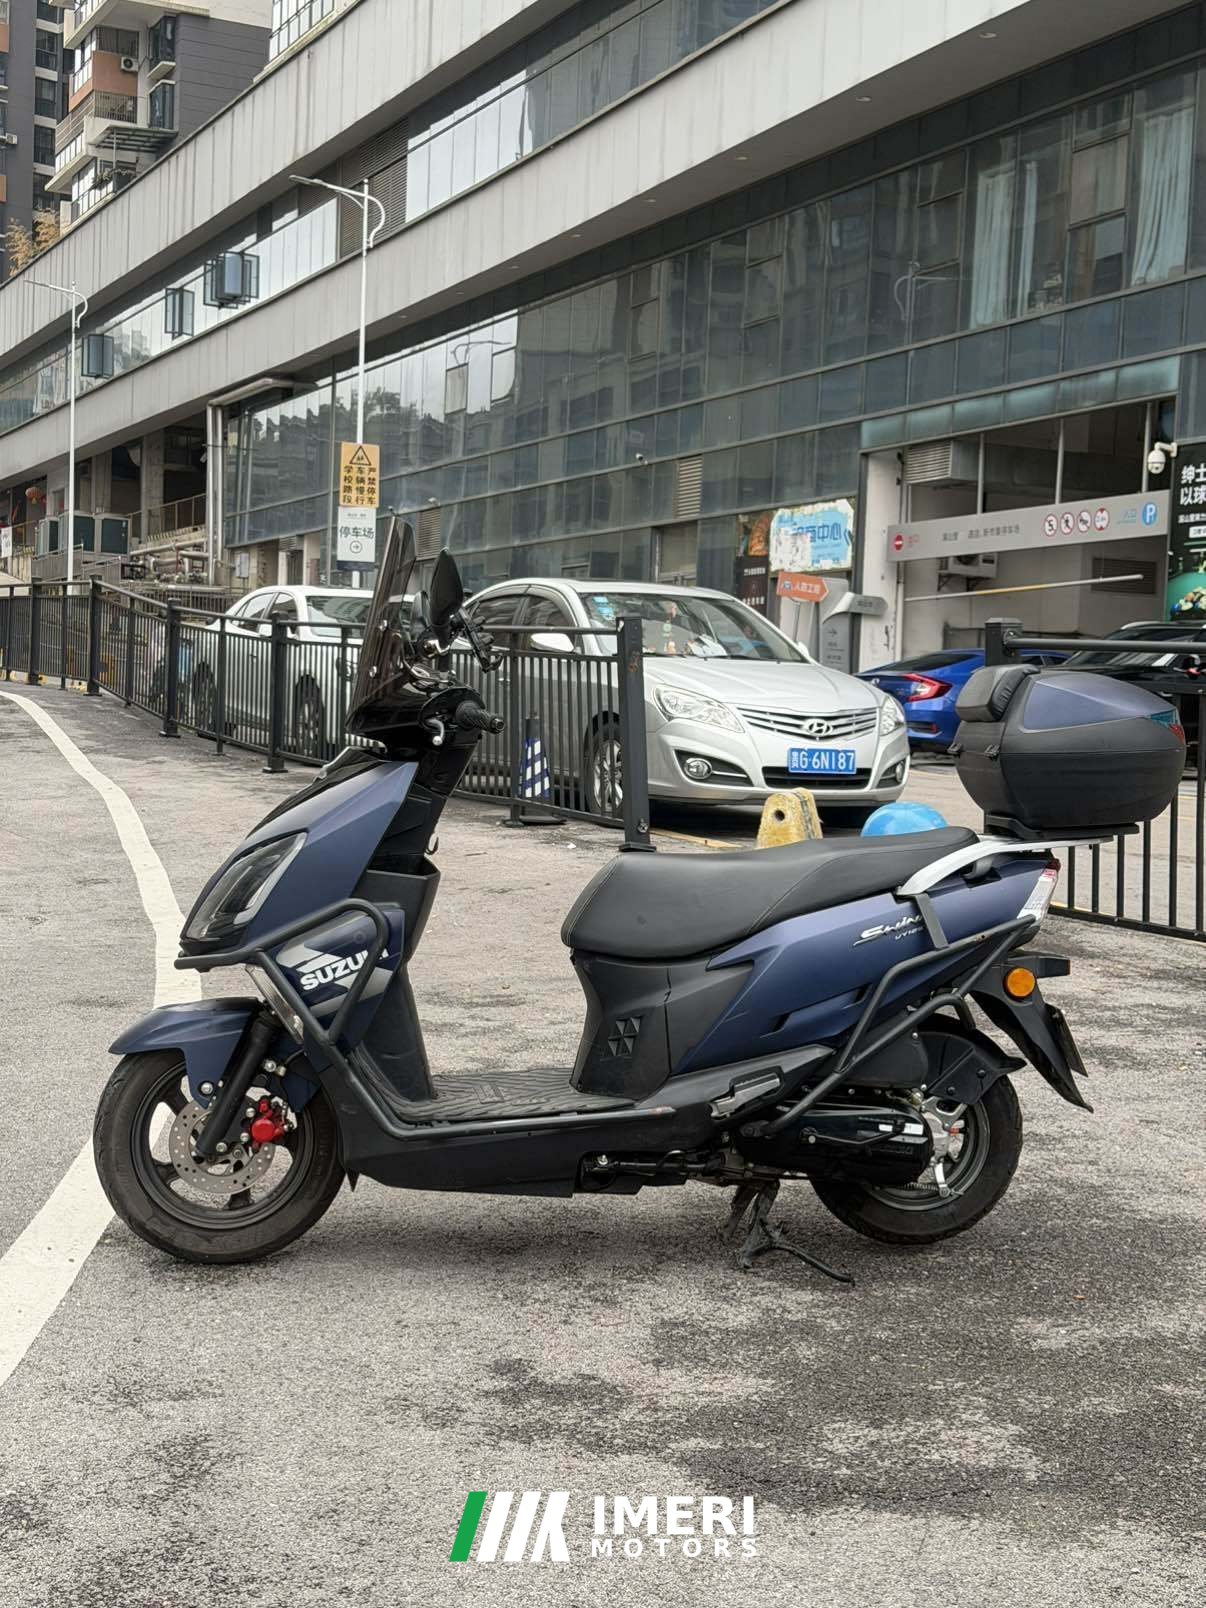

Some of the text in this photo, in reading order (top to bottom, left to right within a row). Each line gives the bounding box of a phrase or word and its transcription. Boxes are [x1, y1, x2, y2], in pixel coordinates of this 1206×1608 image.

[367, 467, 377, 505] 严禁停车
[1181, 463, 1206, 484] 绅士
[339, 526, 375, 540] 停车场
[300, 948, 389, 990] SUZU
